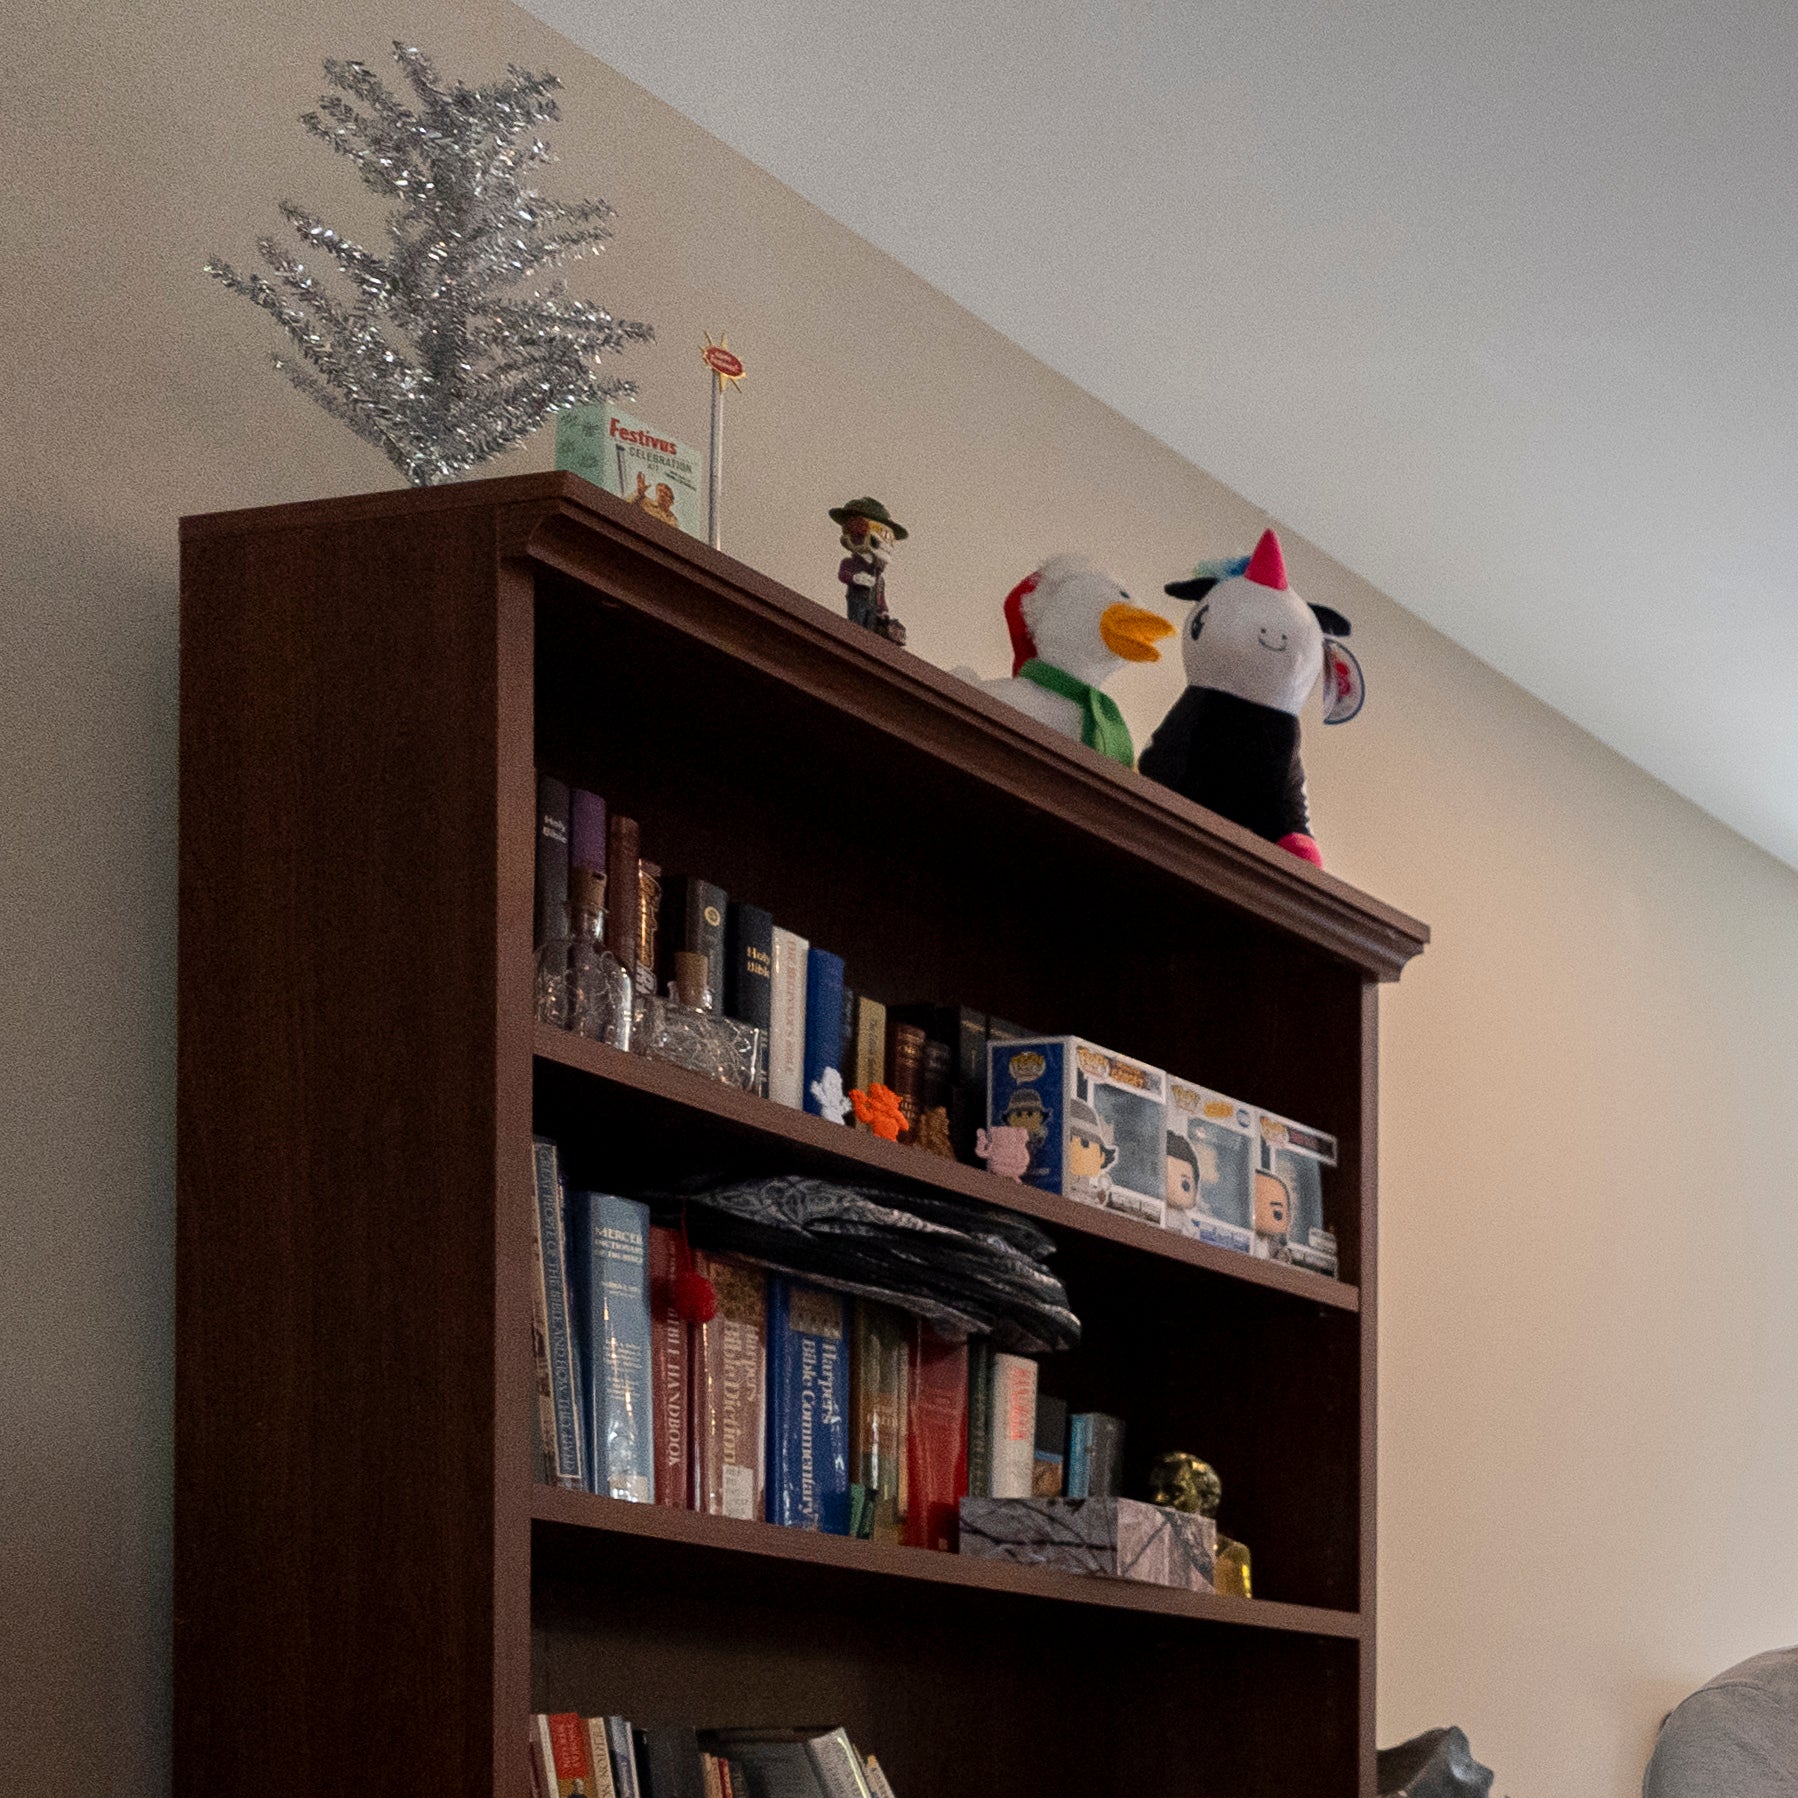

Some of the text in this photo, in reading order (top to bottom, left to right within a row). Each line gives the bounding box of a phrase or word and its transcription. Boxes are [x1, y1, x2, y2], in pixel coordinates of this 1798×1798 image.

[609, 417, 677, 455] Festivus
[629, 446, 692, 473] CELEBRATION
[539, 1150, 575, 1470] GREAT PEOPLE OF THE BIBLE AND HOW THEY LIVED
[667, 1363, 681, 1467] HANDBOOK
[722, 1319, 741, 1466] Bible Diction
[798, 1338, 816, 1516] Bible Commentary
